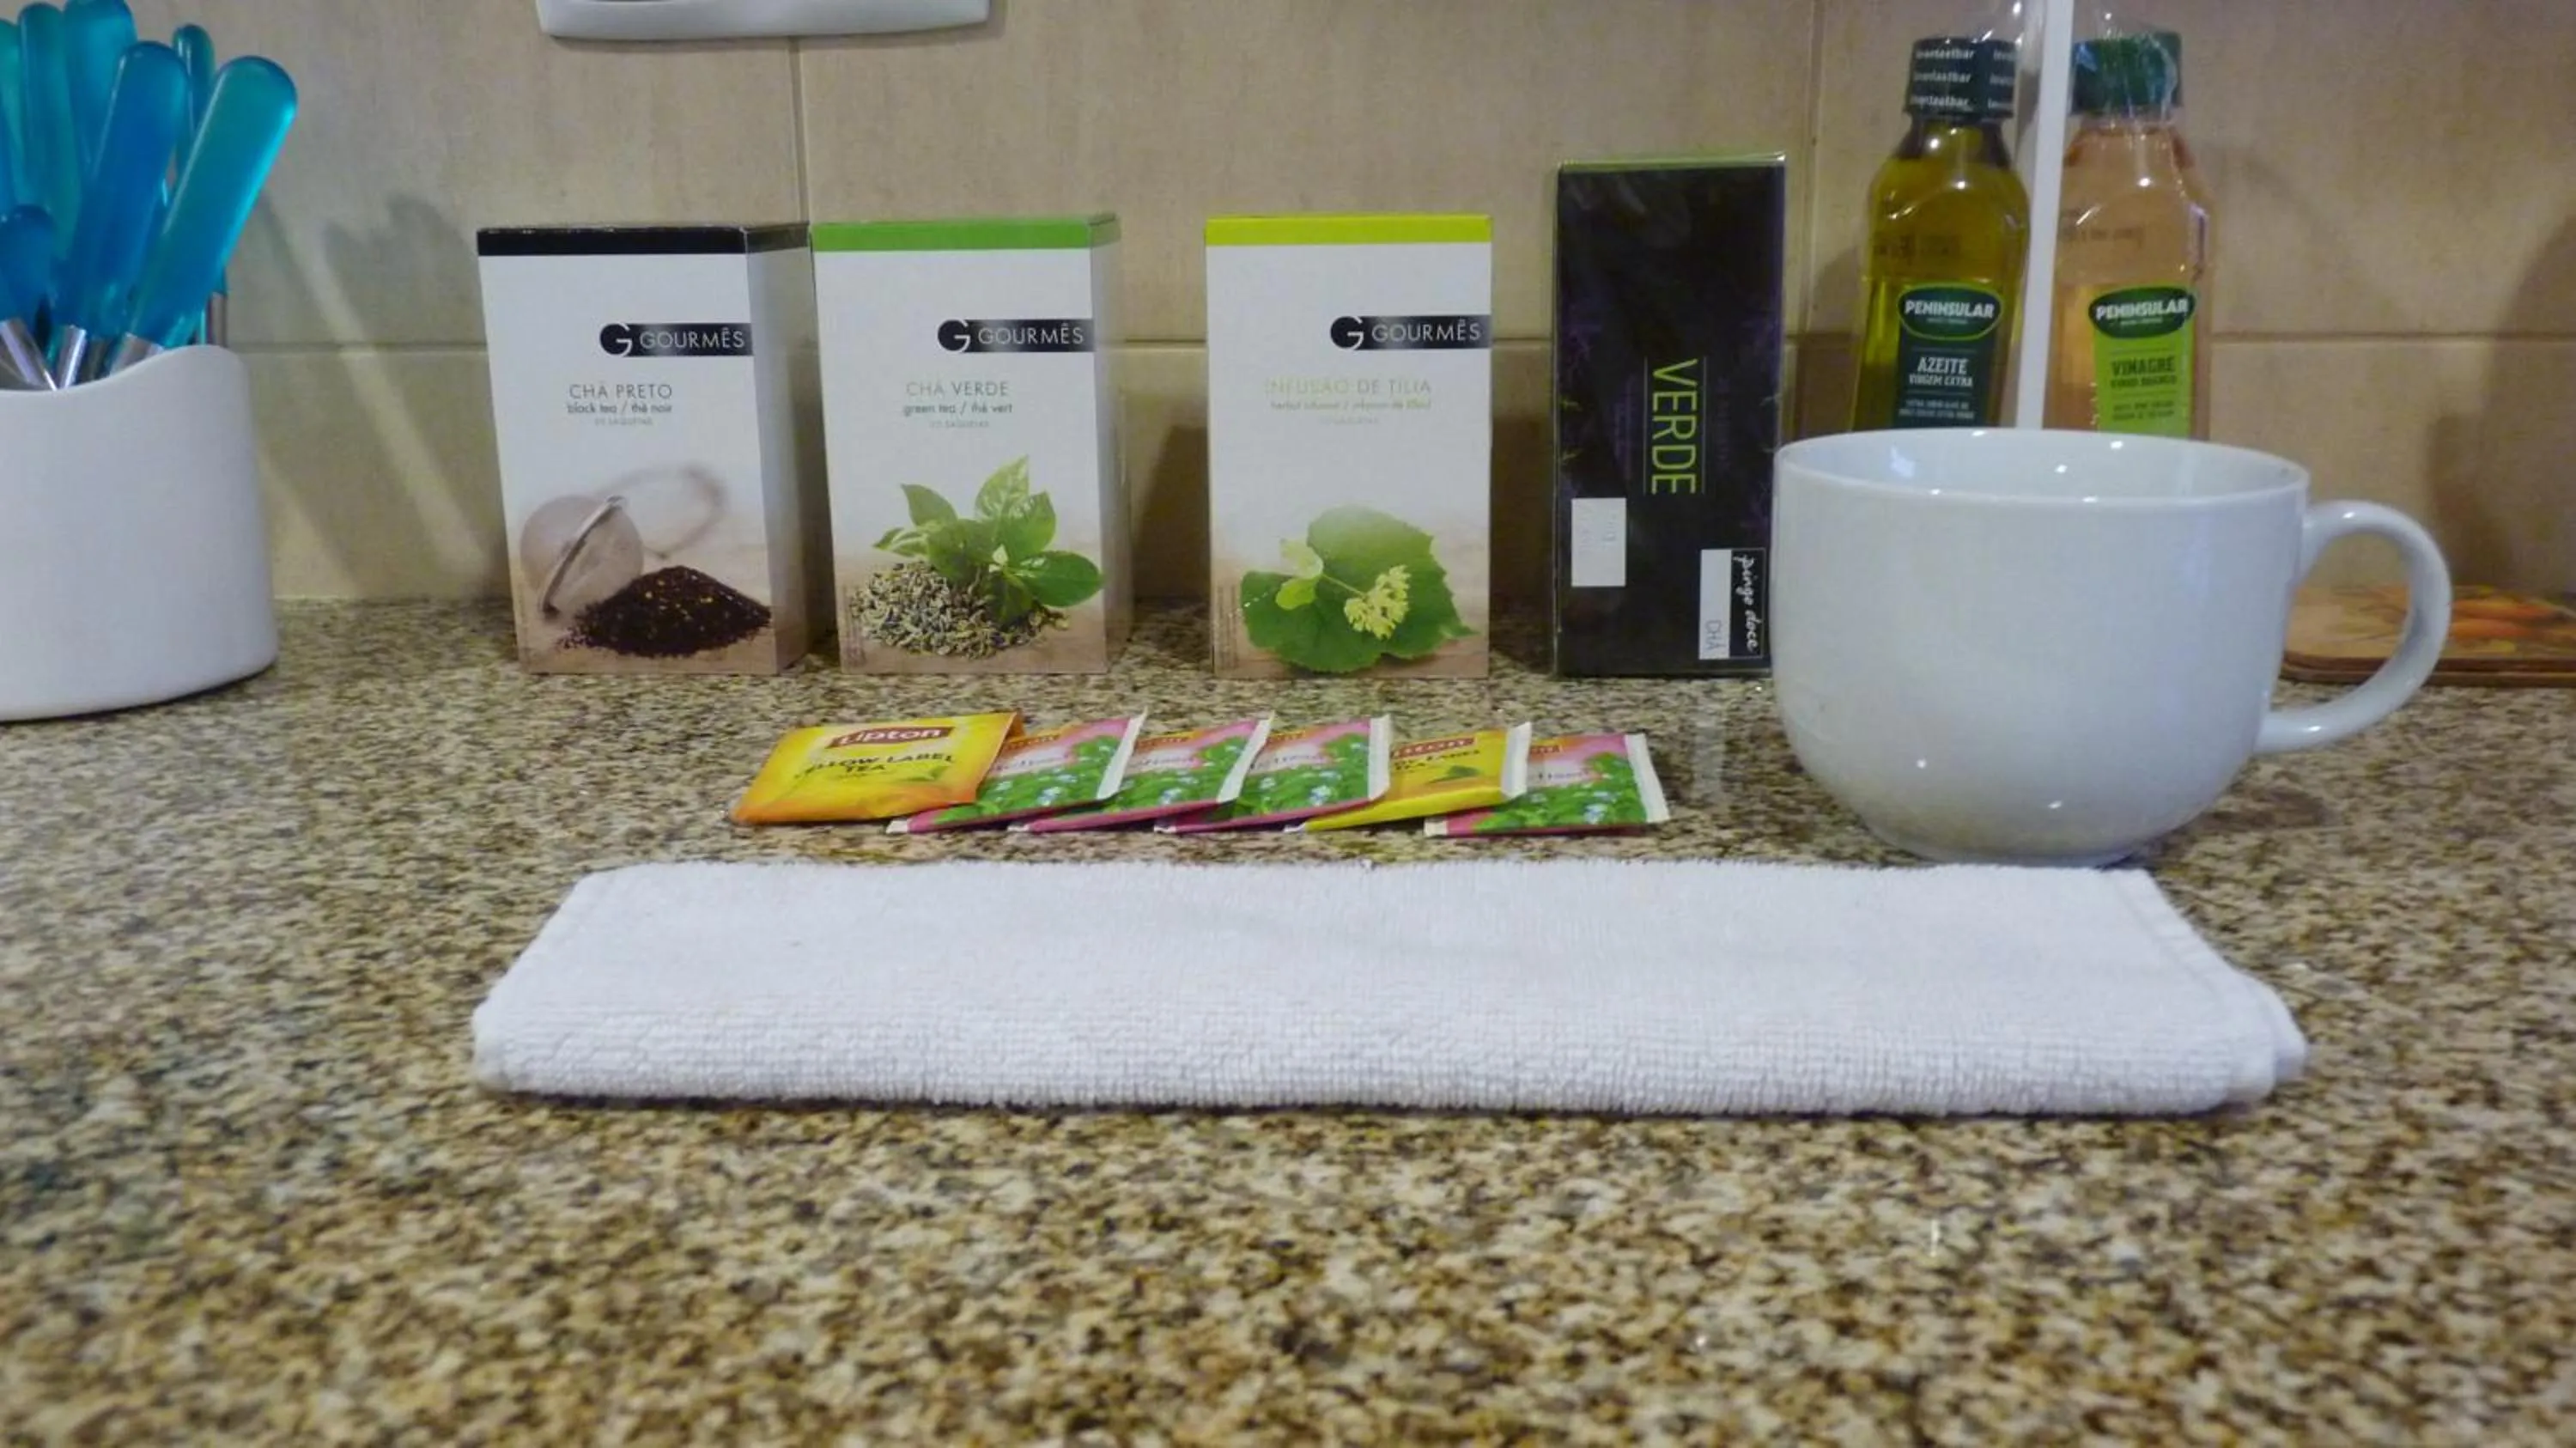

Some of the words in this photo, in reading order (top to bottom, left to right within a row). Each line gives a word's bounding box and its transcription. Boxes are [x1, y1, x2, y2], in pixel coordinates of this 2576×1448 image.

[1905, 300, 1994, 319] PENINSULAR
[2095, 298, 2189, 320] PENINSULAR
[640, 326, 744, 349] GOURMÊS
[978, 322, 1084, 344] GOURMÊS
[1371, 319, 1481, 342] GOURMÊS
[1917, 356, 1969, 375] AZEITE
[616, 383, 673, 399] PRETO
[951, 380, 1009, 397] VERDE
[1357, 379, 1379, 394] DE
[567, 401, 596, 413] black
[904, 405, 936, 417] green
[992, 404, 1012, 413] vert
[1651, 358, 1699, 496] VERDE
[1733, 555, 1759, 605] pingo
[1744, 609, 1763, 653] doce
[839, 728, 942, 746] Lipton
[886, 752, 954, 764] LABEL
